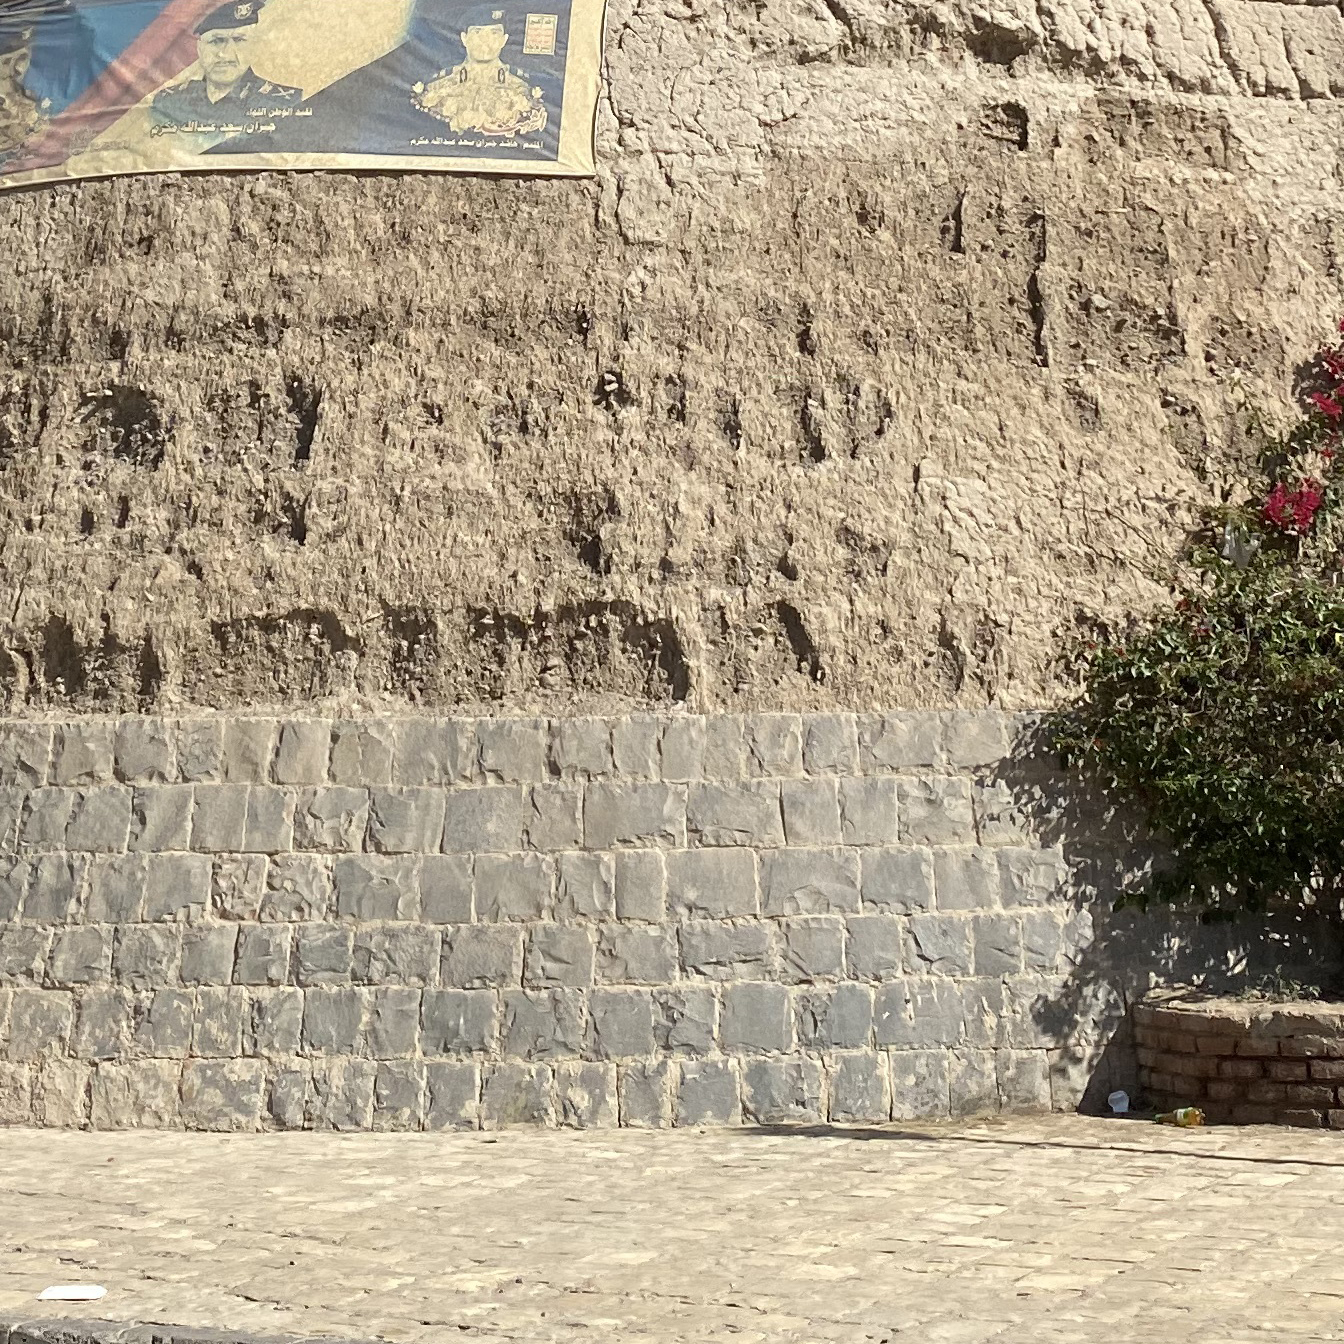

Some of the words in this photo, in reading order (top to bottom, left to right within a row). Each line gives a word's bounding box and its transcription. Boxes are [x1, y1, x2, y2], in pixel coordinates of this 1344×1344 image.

[245, 107, 267, 118] اللواء
[268, 107, 293, 118] الوطن
[180, 120, 216, 134] عبدالله
[219, 121, 244, 133] سعد
[246, 121, 276, 134] جبران
[410, 135, 429, 146] مكرم
[430, 136, 456, 145] عبدالله
